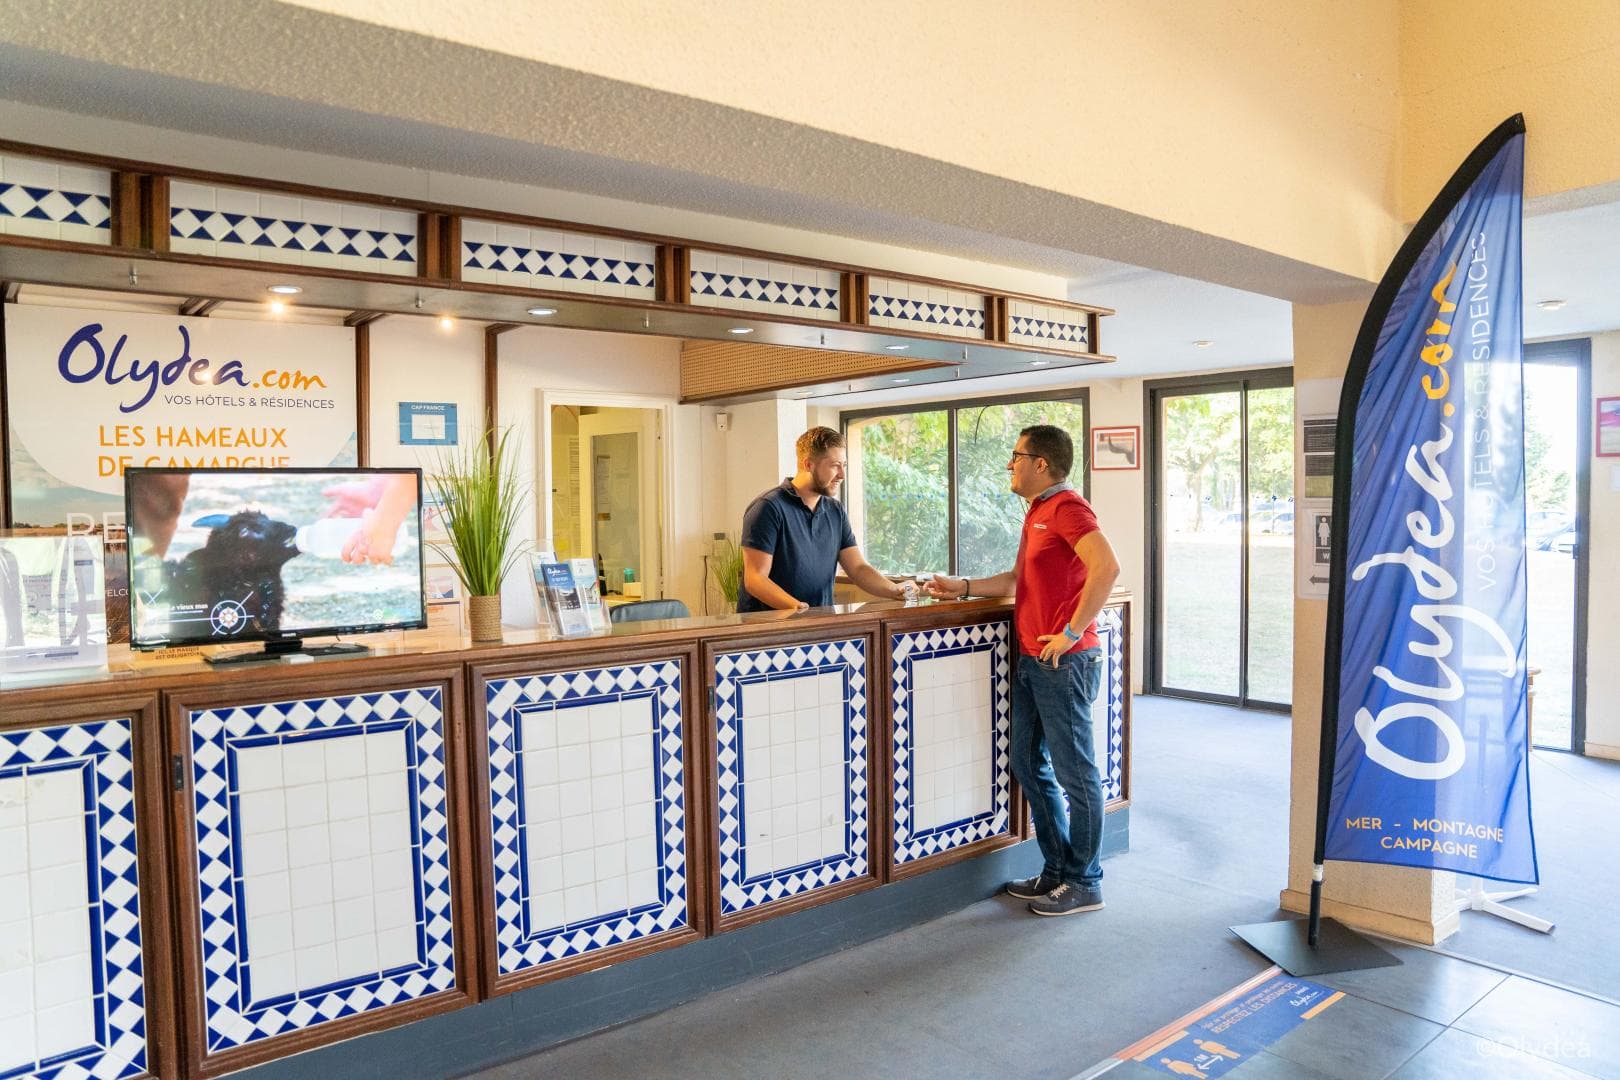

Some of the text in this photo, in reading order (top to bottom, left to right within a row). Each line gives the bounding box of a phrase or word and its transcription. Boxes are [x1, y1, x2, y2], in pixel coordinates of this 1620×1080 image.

[58, 323, 327, 413] Olydea.com
[164, 393, 335, 410] VOS HÔTELS & RÉSIDENCES
[1473, 403, 1491, 421] &
[99, 425, 288, 448] LES HAMEAUX
[1351, 261, 1517, 780] Olydea.com
[1477, 539, 1497, 592] VOS
[1346, 817, 1382, 830] MER
[1413, 818, 1504, 843] MONTAGNE
[1380, 837, 1478, 859] CAMPAGNE
